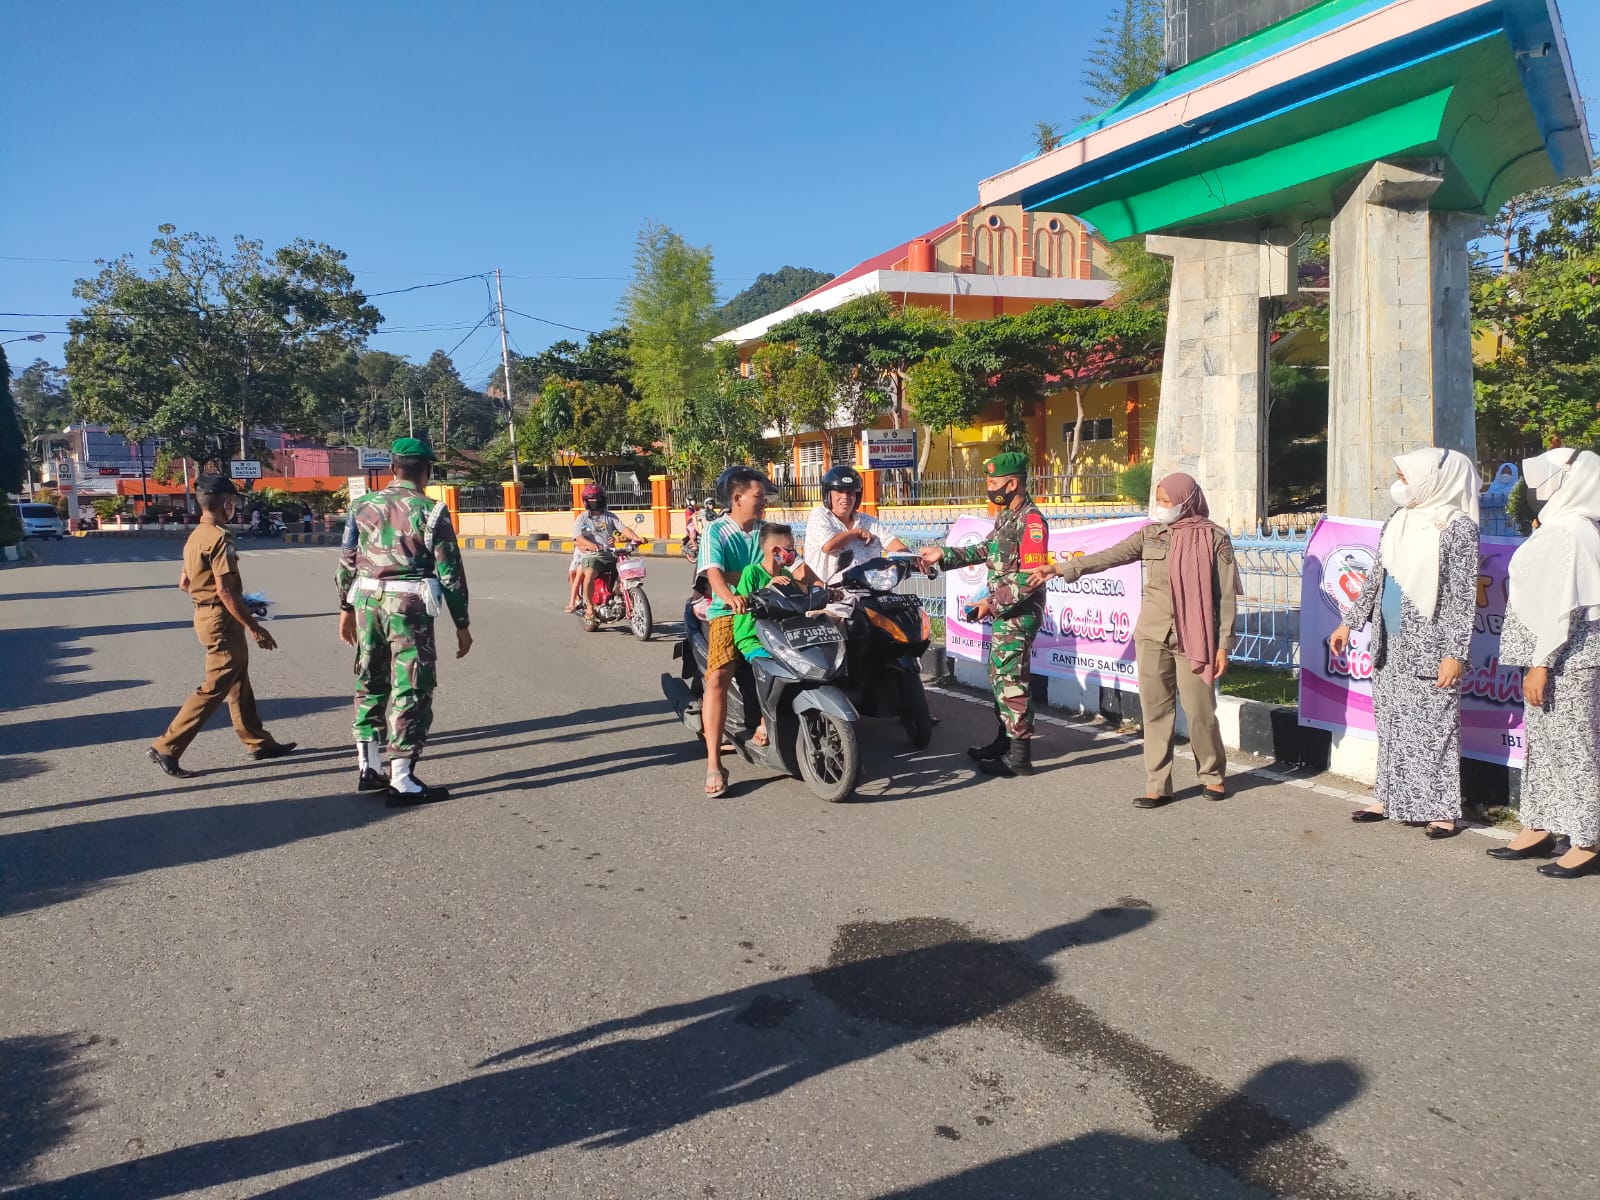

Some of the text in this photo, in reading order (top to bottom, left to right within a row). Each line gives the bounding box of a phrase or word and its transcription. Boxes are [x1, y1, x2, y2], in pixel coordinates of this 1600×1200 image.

[1060, 578, 1125, 596] INDONESIA
[1061, 606, 1131, 642] Covid-19
[1052, 652, 1095, 668] RANTING
[1097, 659, 1135, 675] SALIDO
[1501, 733, 1523, 748] IBI
